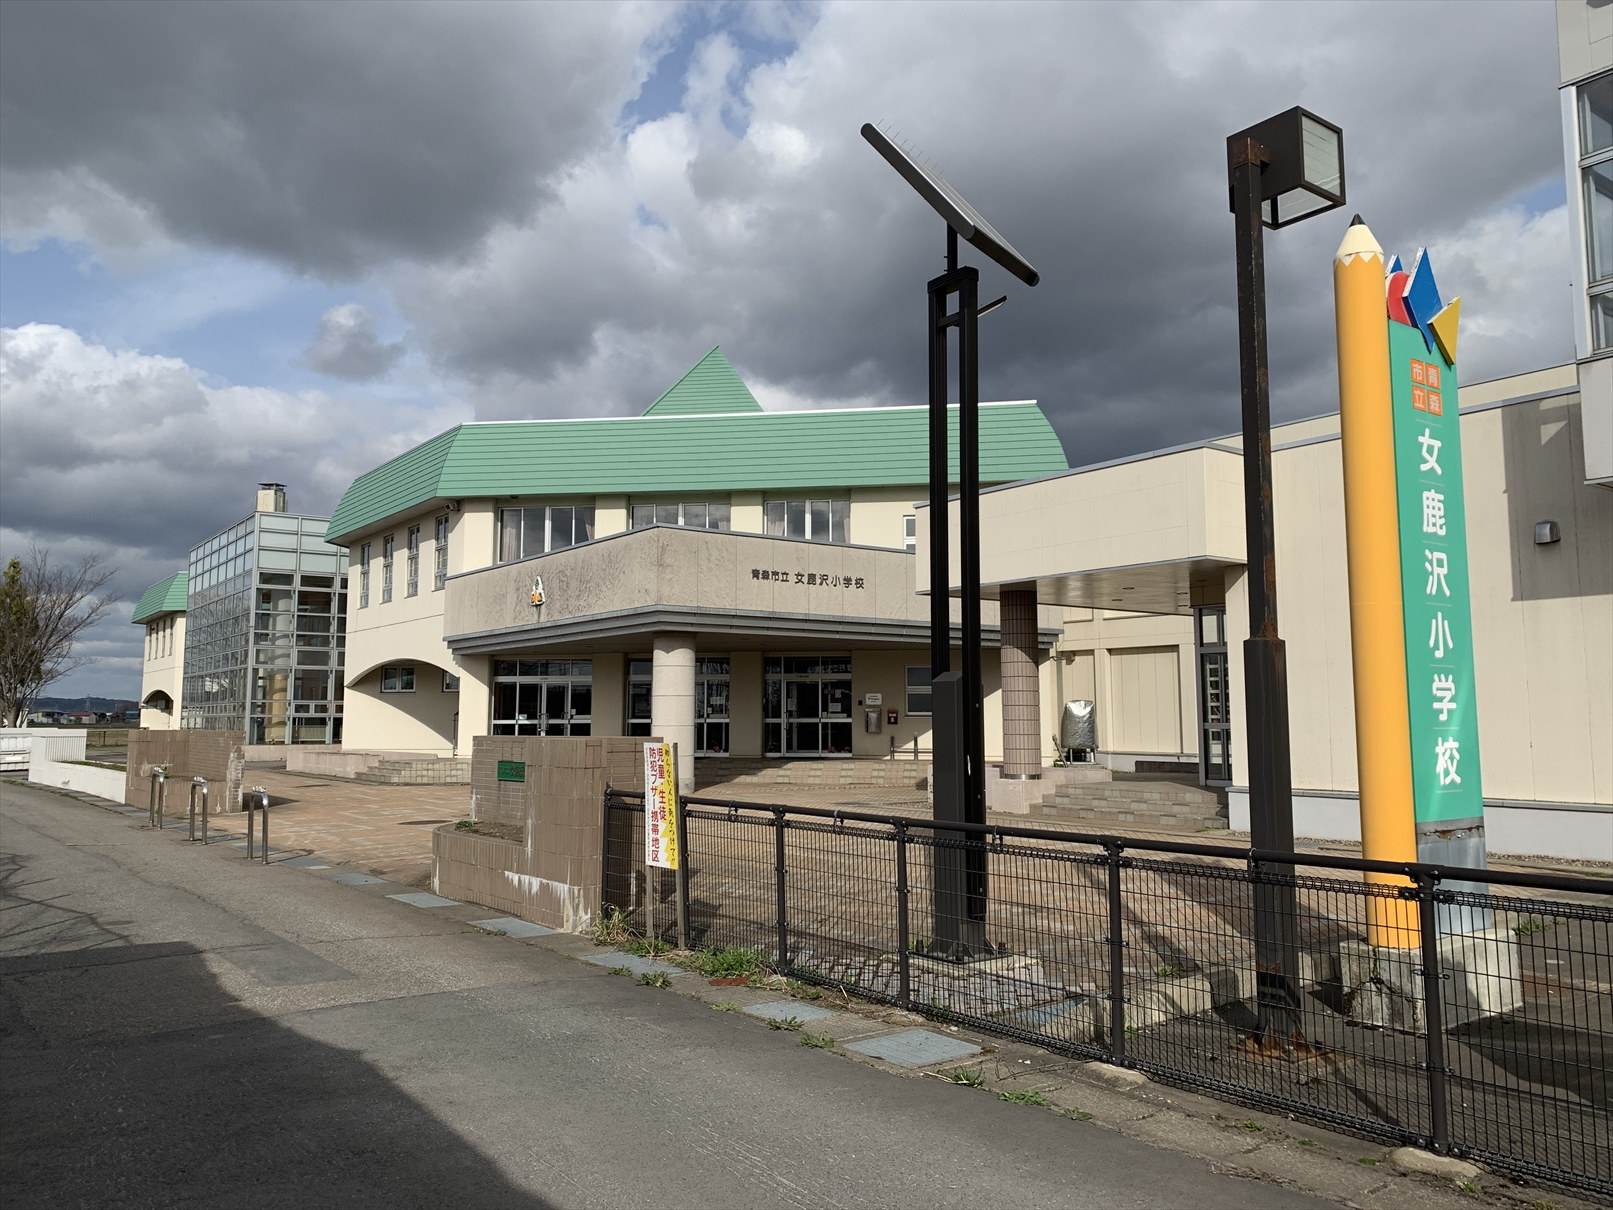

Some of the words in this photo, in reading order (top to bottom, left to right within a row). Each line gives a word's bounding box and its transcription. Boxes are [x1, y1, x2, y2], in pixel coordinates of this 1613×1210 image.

[1412, 363, 1425, 408] 市立
[751, 569, 789, 582] 青森市立
[794, 571, 864, 589] 女鹿沢小学校
[1418, 428, 1462, 787] 女鹿沢小学校
[649, 747, 660, 862] 防犯ブザー携帯地区
